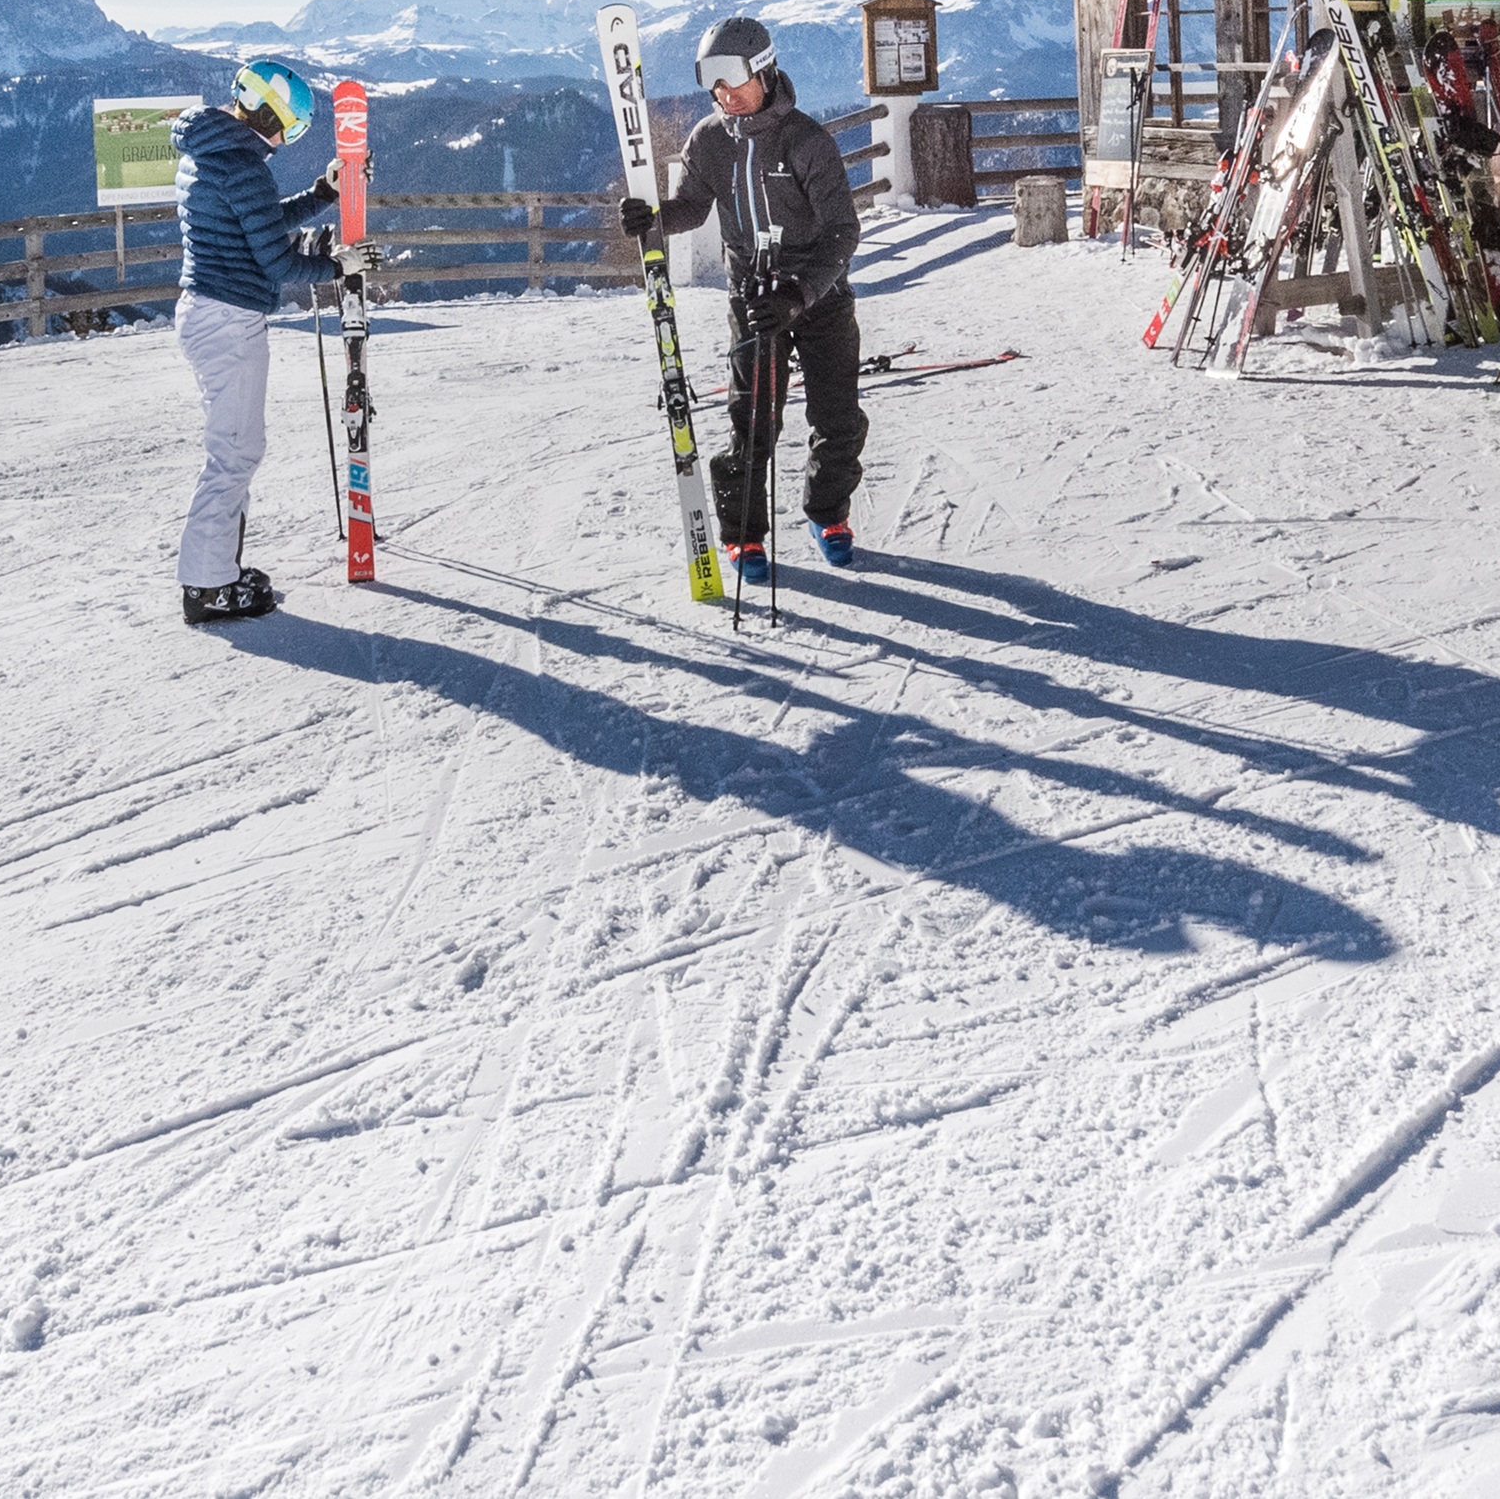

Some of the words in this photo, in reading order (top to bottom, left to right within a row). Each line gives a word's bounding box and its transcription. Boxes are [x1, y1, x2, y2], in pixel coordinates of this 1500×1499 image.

[613, 43, 647, 168] HEAD
[1328, 7, 1385, 127] FISCHER
[693, 509, 713, 578] REBELS
